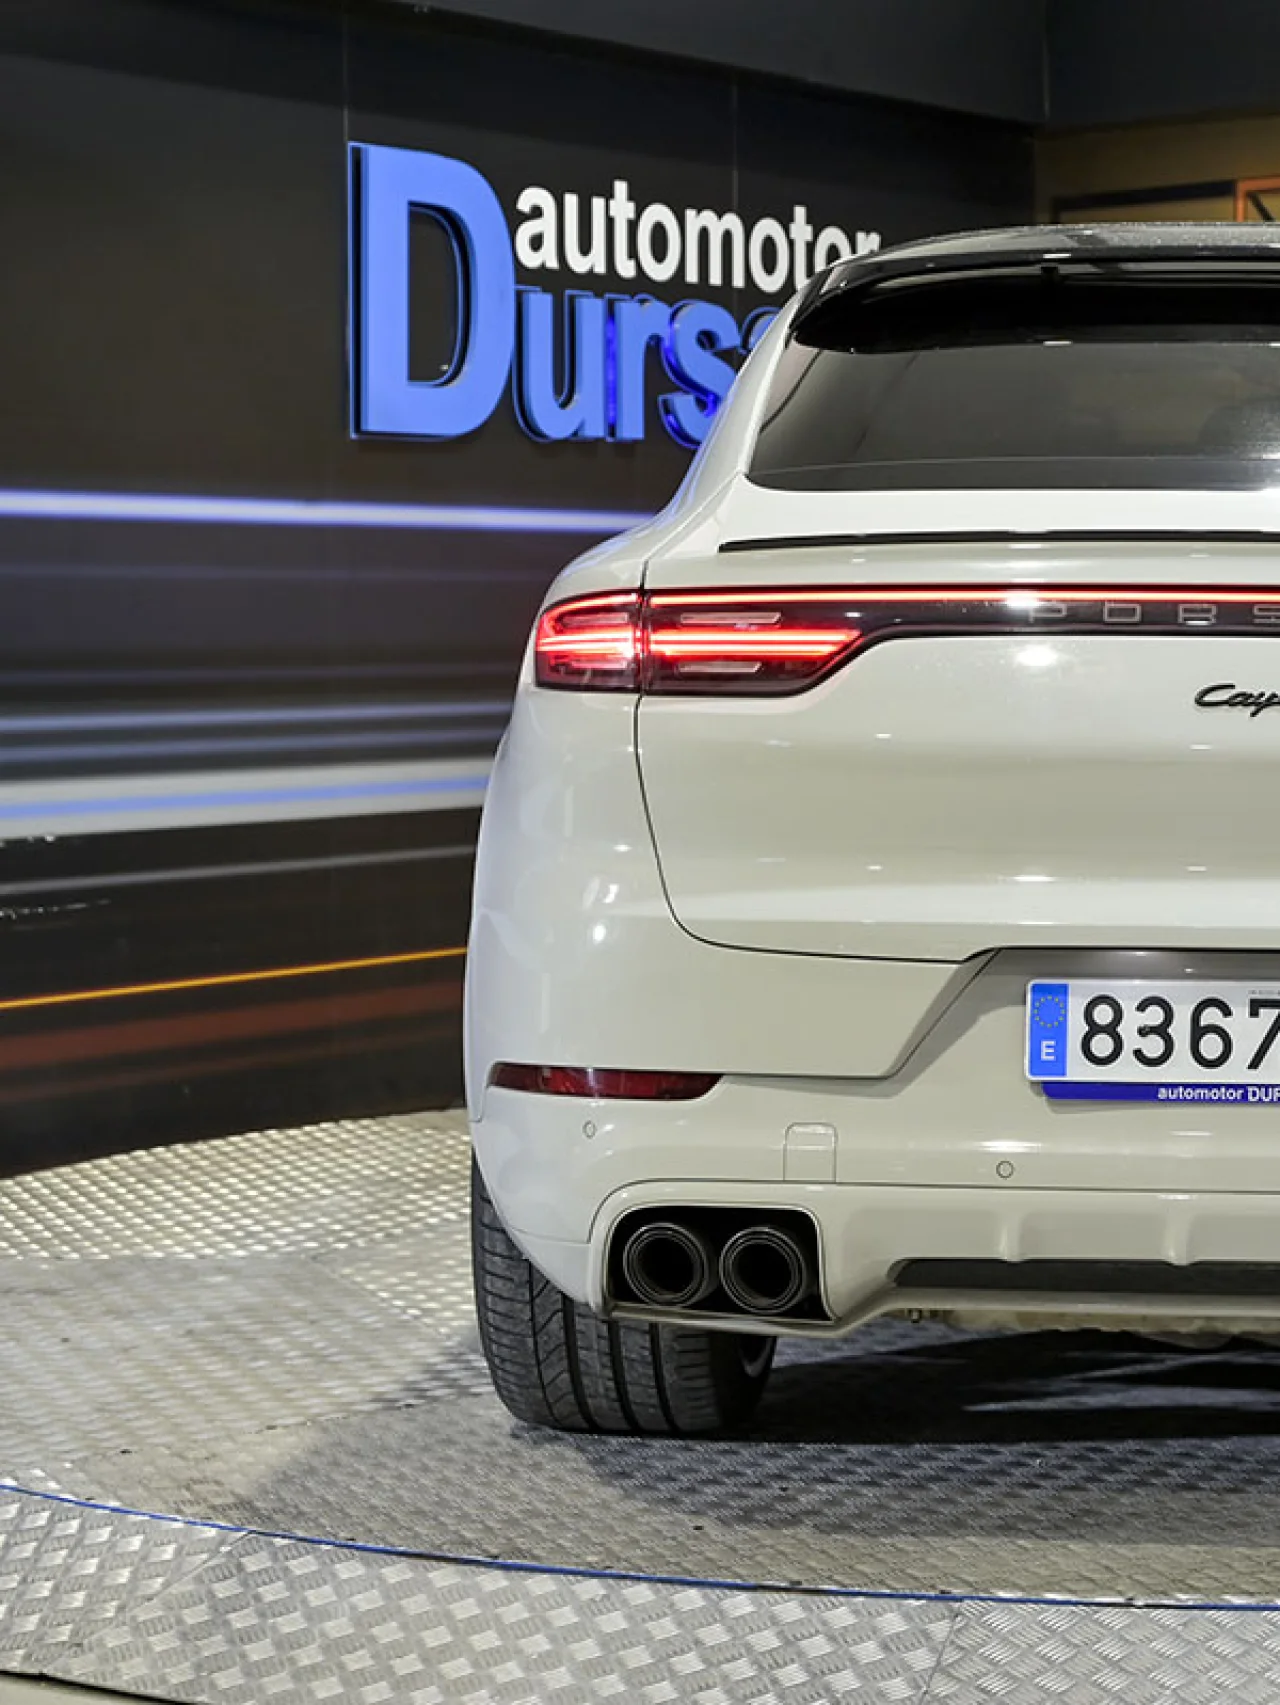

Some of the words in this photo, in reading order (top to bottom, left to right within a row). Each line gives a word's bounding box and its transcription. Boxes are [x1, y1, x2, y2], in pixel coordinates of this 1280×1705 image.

[348, 141, 782, 448] Durs
[1040, 1041, 1056, 1061] E
[1157, 1085, 1244, 1101] automotor
